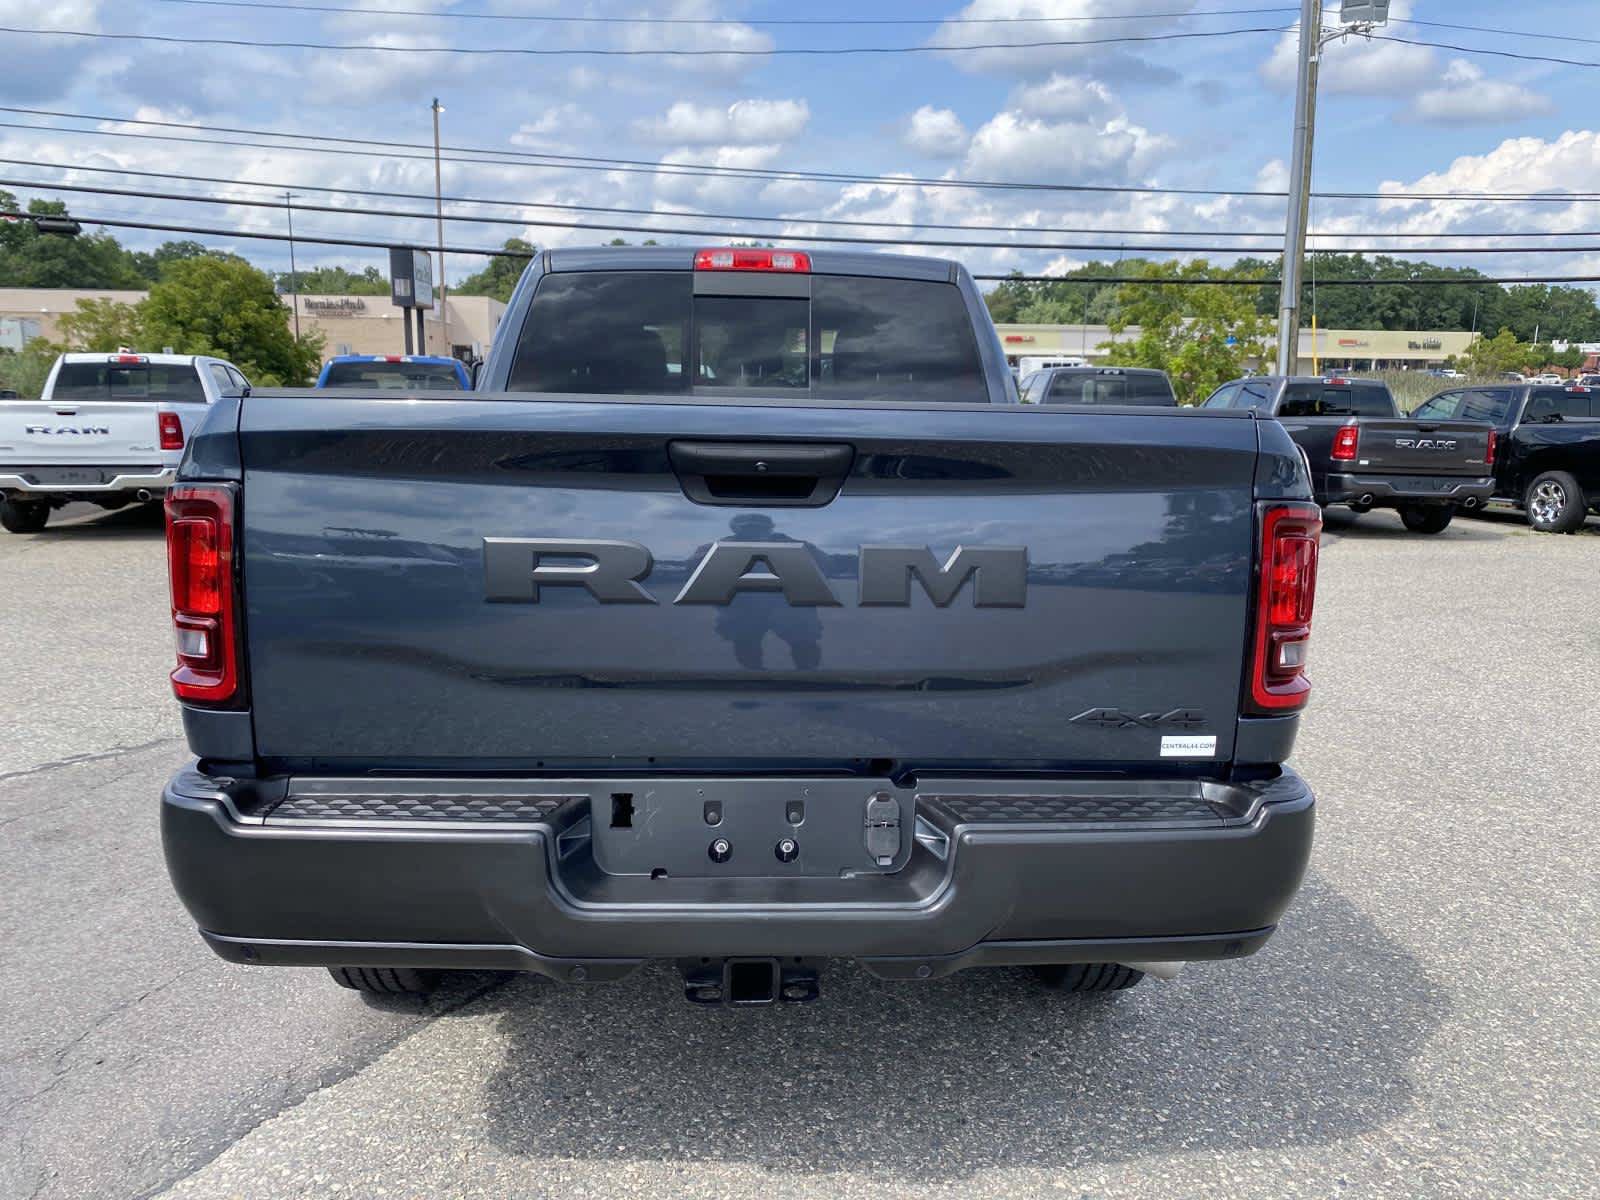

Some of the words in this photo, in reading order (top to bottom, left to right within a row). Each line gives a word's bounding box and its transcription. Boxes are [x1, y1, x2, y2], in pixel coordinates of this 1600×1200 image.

[25, 425, 110, 435] RAM
[1395, 438, 1457, 450] RAM
[482, 536, 1029, 609] RAM
